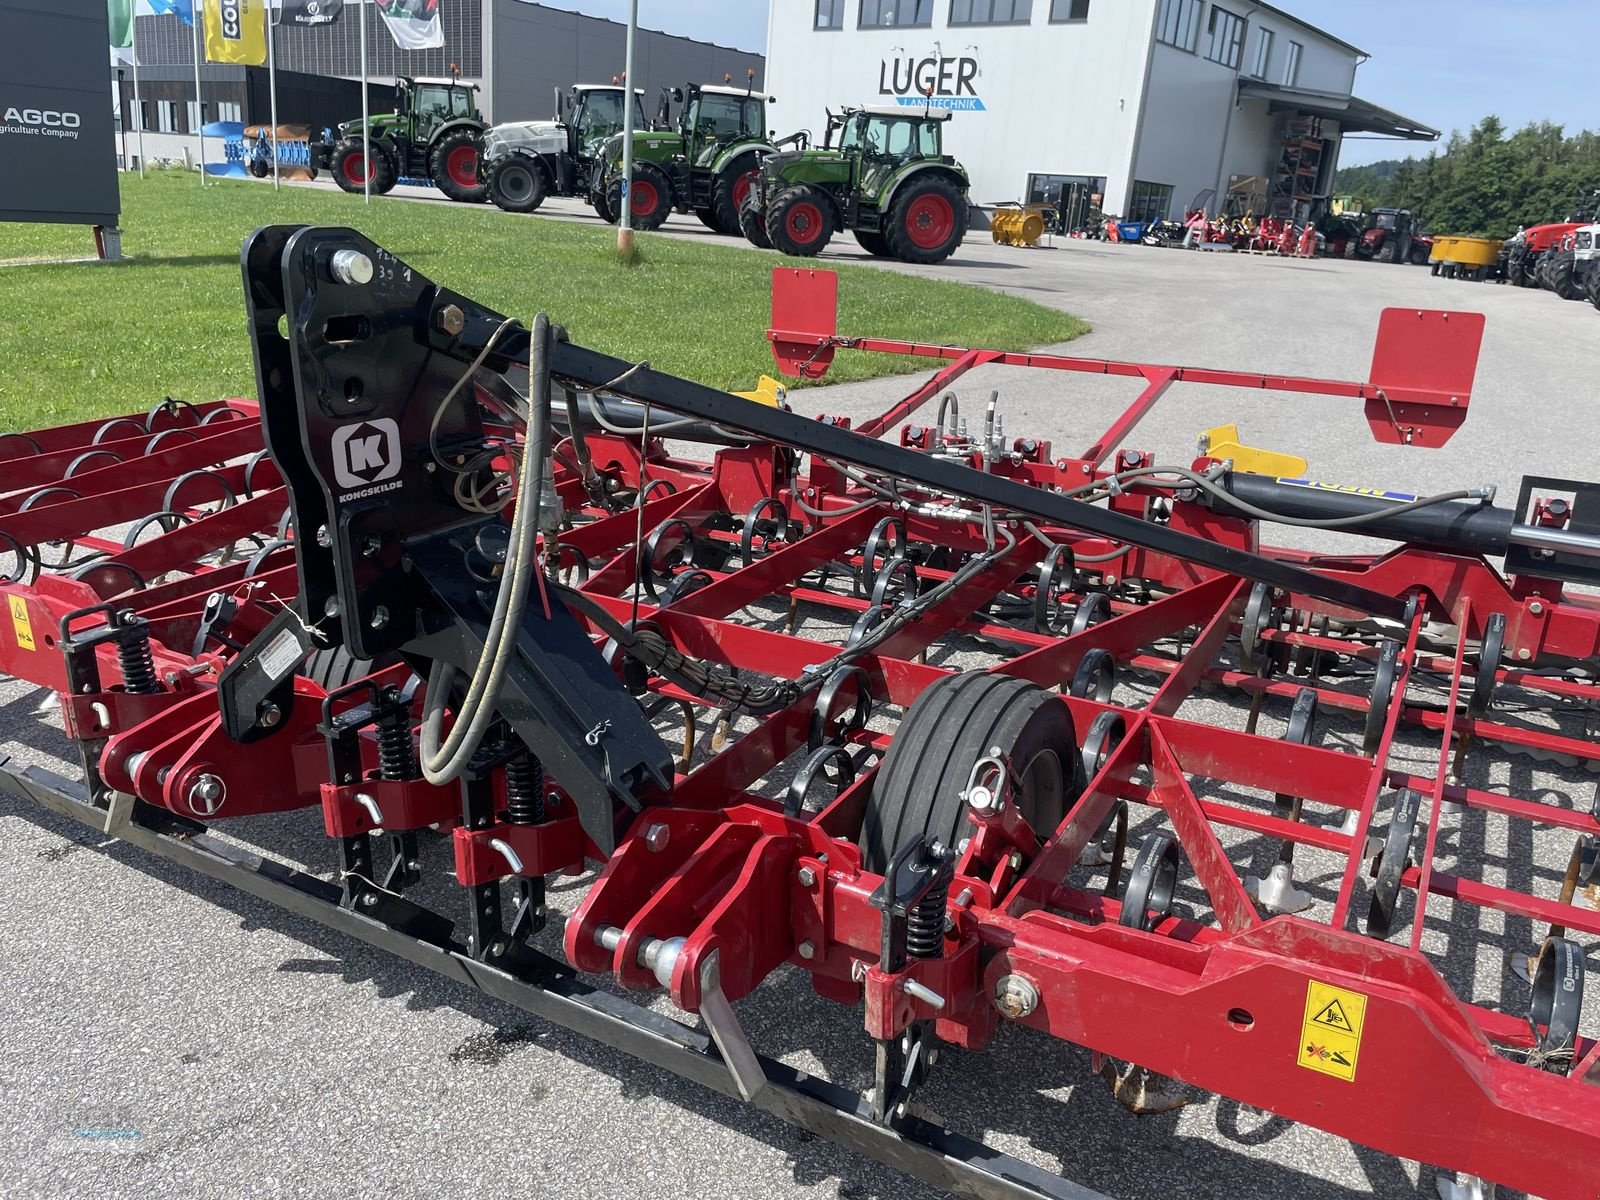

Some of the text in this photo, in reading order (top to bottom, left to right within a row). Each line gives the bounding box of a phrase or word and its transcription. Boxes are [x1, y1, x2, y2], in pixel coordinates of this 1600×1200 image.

[879, 57, 977, 96] LUGER
[4, 107, 80, 127] AGCO
[42, 127, 79, 139] Company
[339, 480, 403, 503] KONGSKILDE
